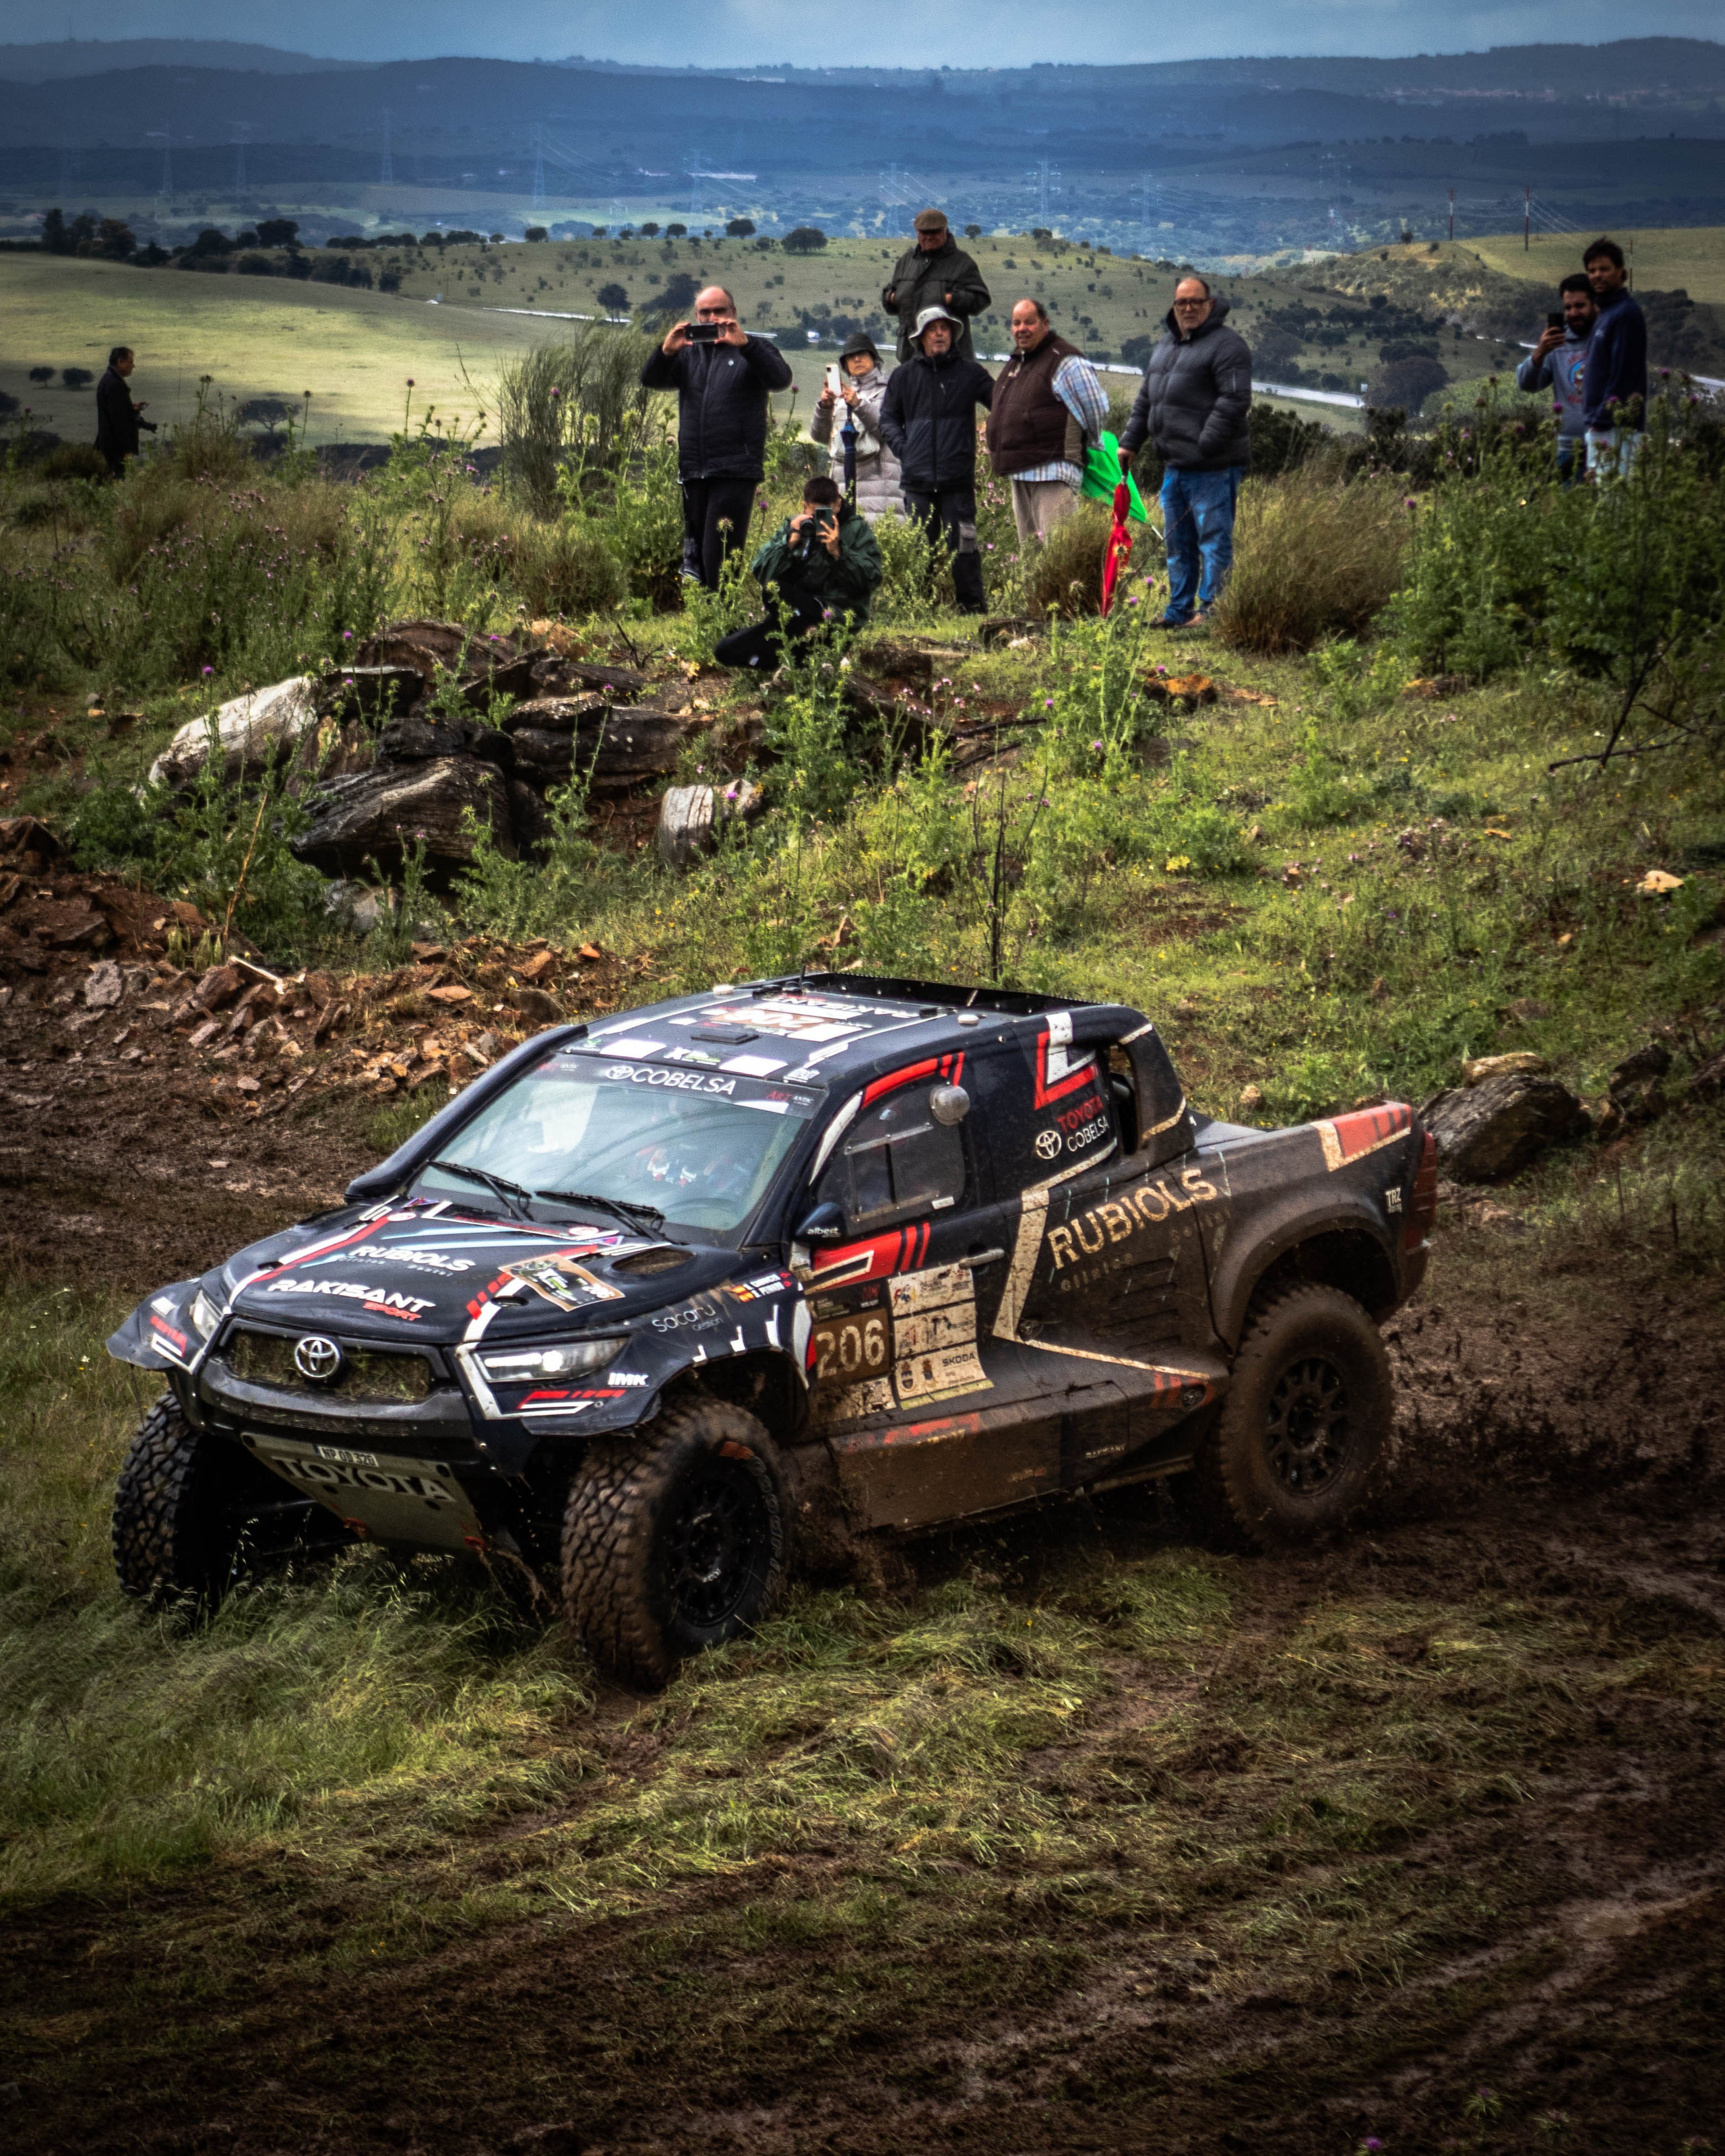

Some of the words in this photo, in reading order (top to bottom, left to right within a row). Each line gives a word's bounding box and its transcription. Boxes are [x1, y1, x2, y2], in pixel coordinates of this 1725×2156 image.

[631, 1067, 736, 1095] COBELSA
[1057, 1095, 1104, 1133] TOYOTA
[1067, 1116, 1110, 1152] COBELSA
[1047, 1169, 1218, 1269] RUBIOLS
[348, 1246, 476, 1271] RUBIOLS
[268, 1279, 437, 1312] RAKISANT
[363, 1301, 422, 1321] SPORT
[815, 1319, 885, 1379] 206
[608, 1372, 649, 1387] IMK
[271, 1455, 458, 1504] TOYOTA
